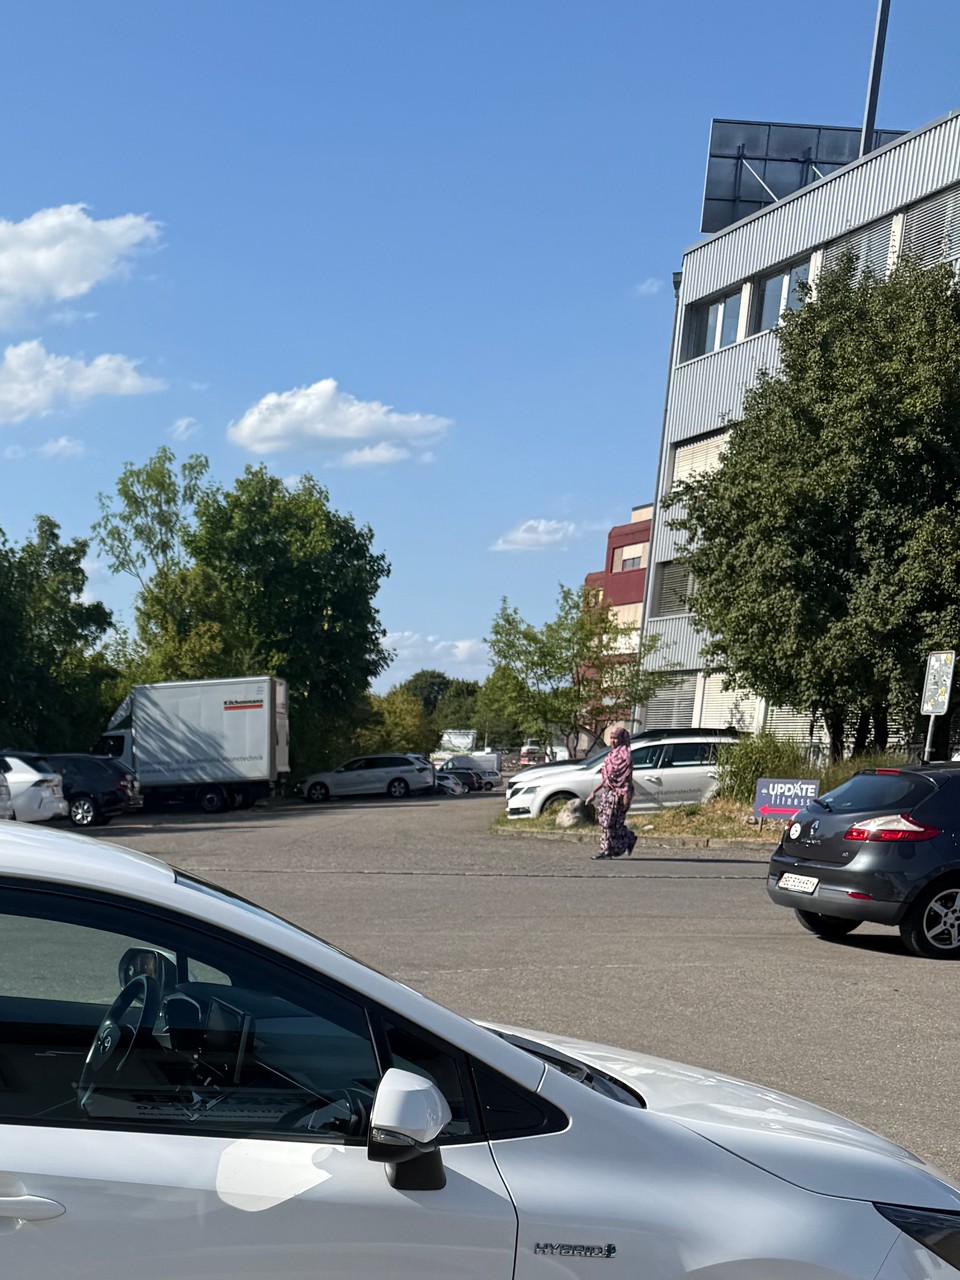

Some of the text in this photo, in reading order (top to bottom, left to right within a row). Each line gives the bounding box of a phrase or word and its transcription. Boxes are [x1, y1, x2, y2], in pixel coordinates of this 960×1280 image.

[769, 780, 816, 798] UPDATE
[771, 795, 810, 806] fitness
[534, 1242, 603, 1257] HYBRID
